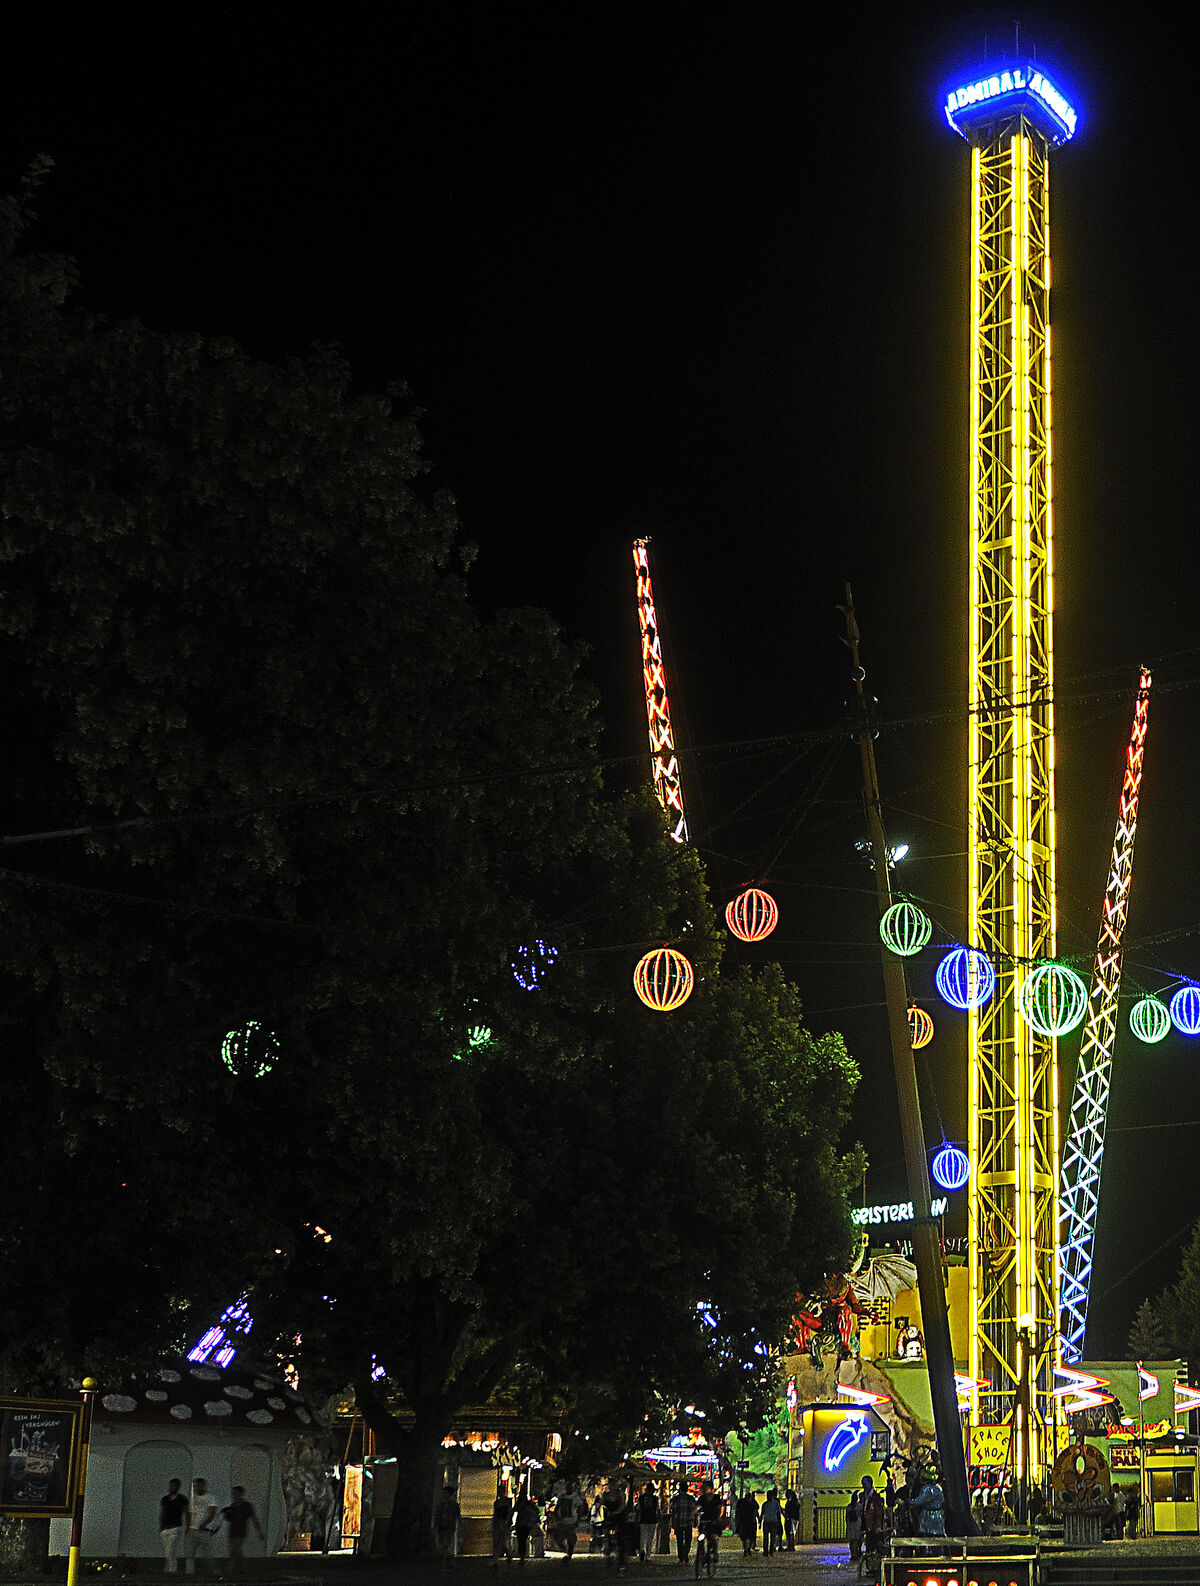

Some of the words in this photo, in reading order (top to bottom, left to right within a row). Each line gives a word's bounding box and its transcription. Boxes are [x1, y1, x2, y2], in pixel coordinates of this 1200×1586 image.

[947, 69, 1026, 113] ADMIRAL
[972, 1429, 1009, 1448] SPACE
[976, 1447, 1004, 1463] SHOT
